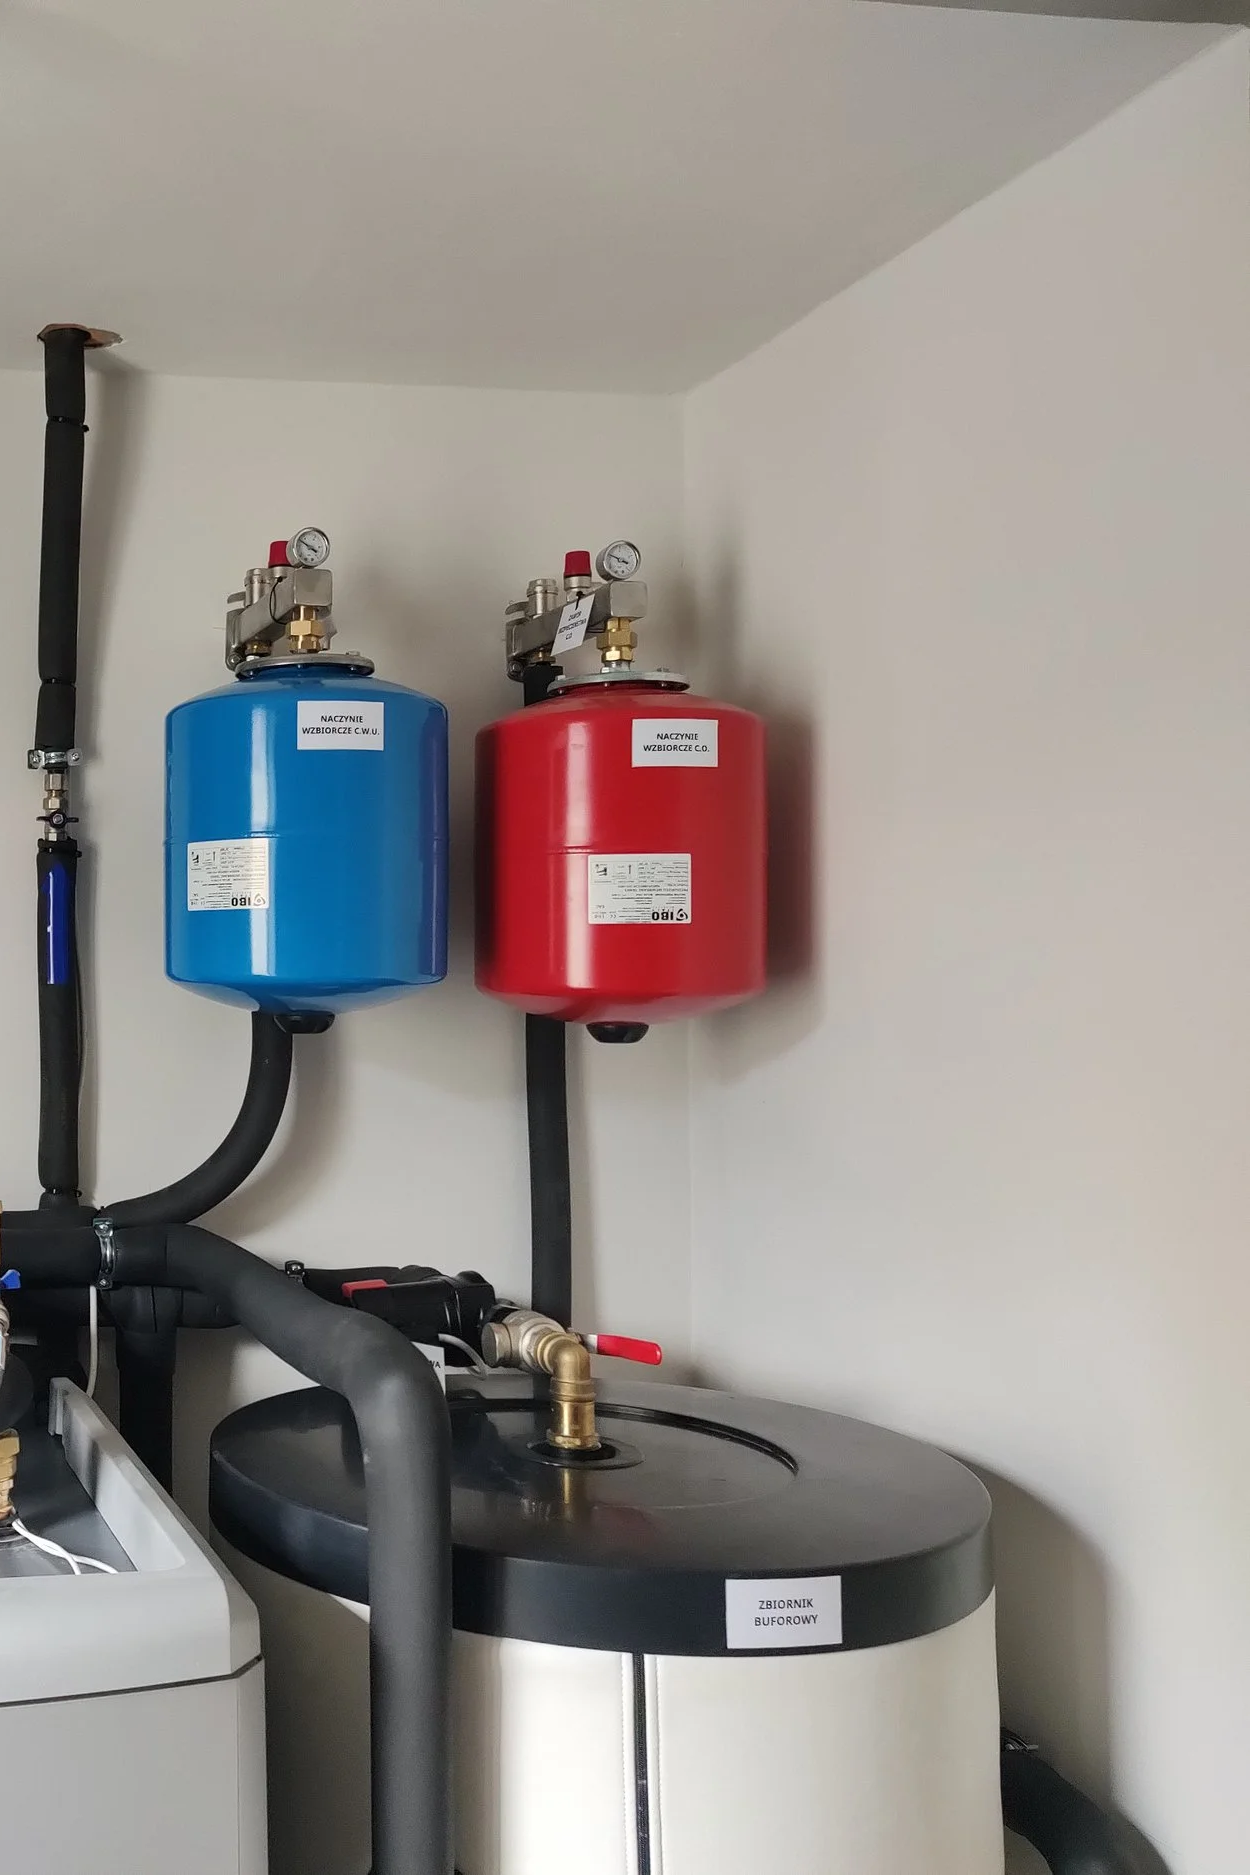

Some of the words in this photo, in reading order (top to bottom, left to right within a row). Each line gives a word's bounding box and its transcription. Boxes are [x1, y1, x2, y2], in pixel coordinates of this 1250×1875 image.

[320, 715, 364, 723] NACZYNIE
[302, 726, 352, 735] WZBIORCZE
[354, 727, 380, 736] C.W.U.
[656, 732, 699, 741] NACZYNIE
[643, 744, 693, 752] WZBIORCZE
[694, 744, 710, 753] C.O.
[231, 897, 251, 907] IBO
[651, 911, 674, 921] IBO
[758, 1598, 814, 1610] ZBIORNIK
[754, 1614, 818, 1627] BUFOROWY
